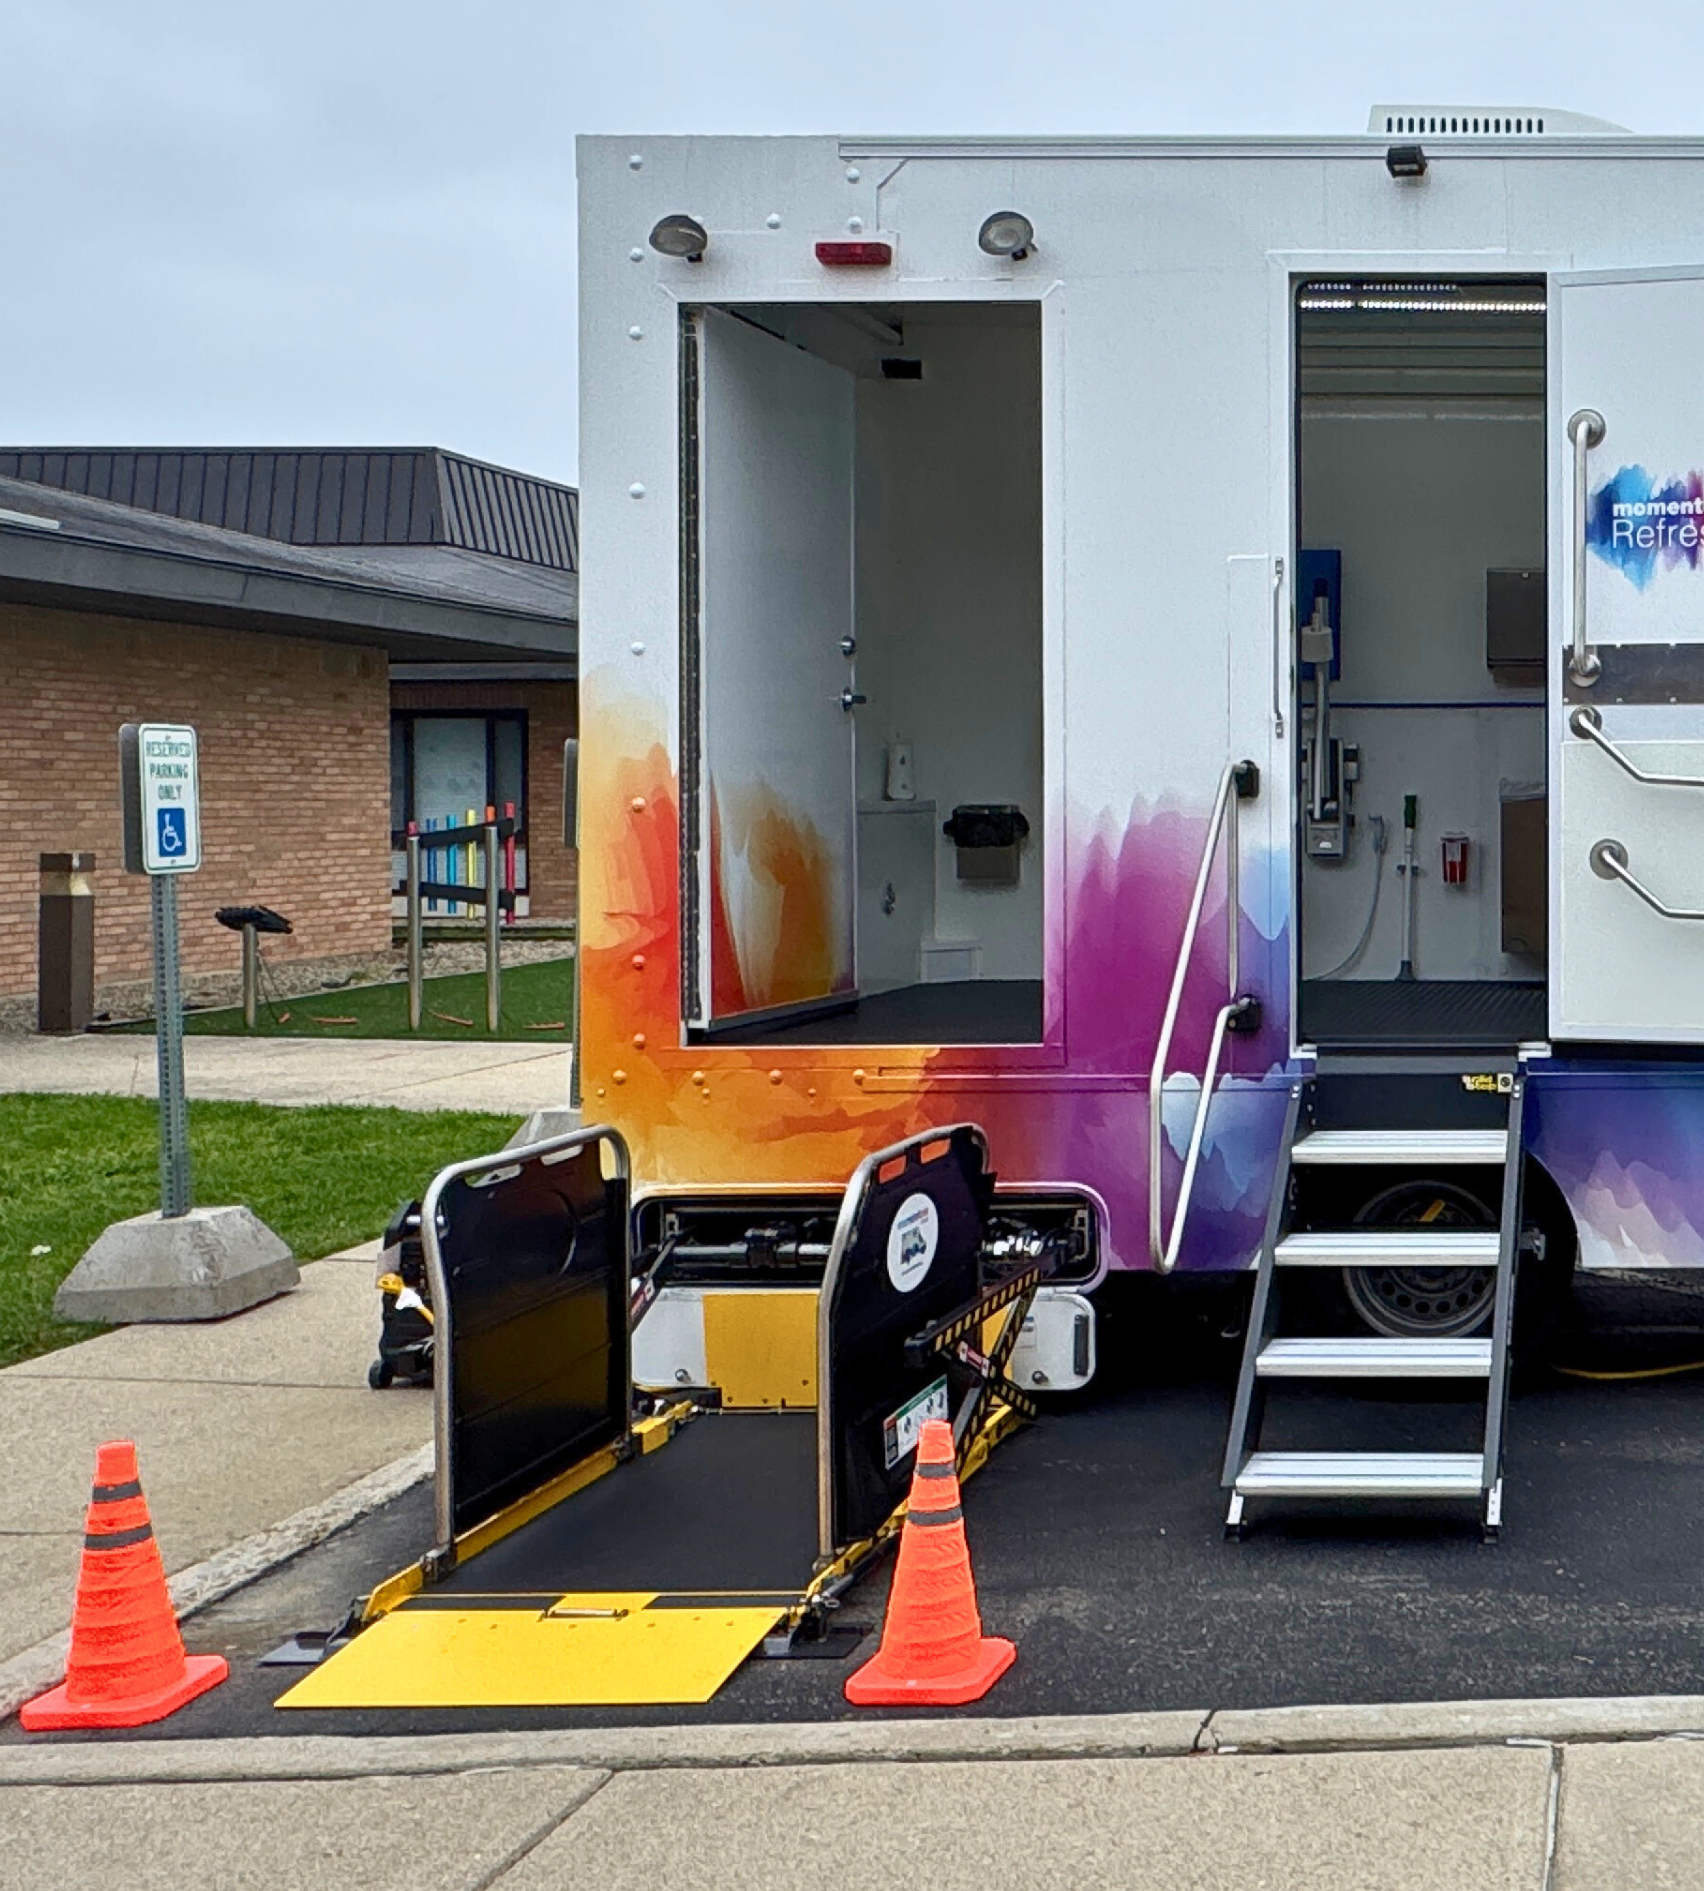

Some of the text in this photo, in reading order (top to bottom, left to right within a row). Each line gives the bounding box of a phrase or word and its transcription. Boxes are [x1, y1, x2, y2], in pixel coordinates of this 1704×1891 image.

[146, 741, 191, 758] RESERVED
[150, 763, 189, 779] PARKING
[158, 785, 182, 800] ONLY
